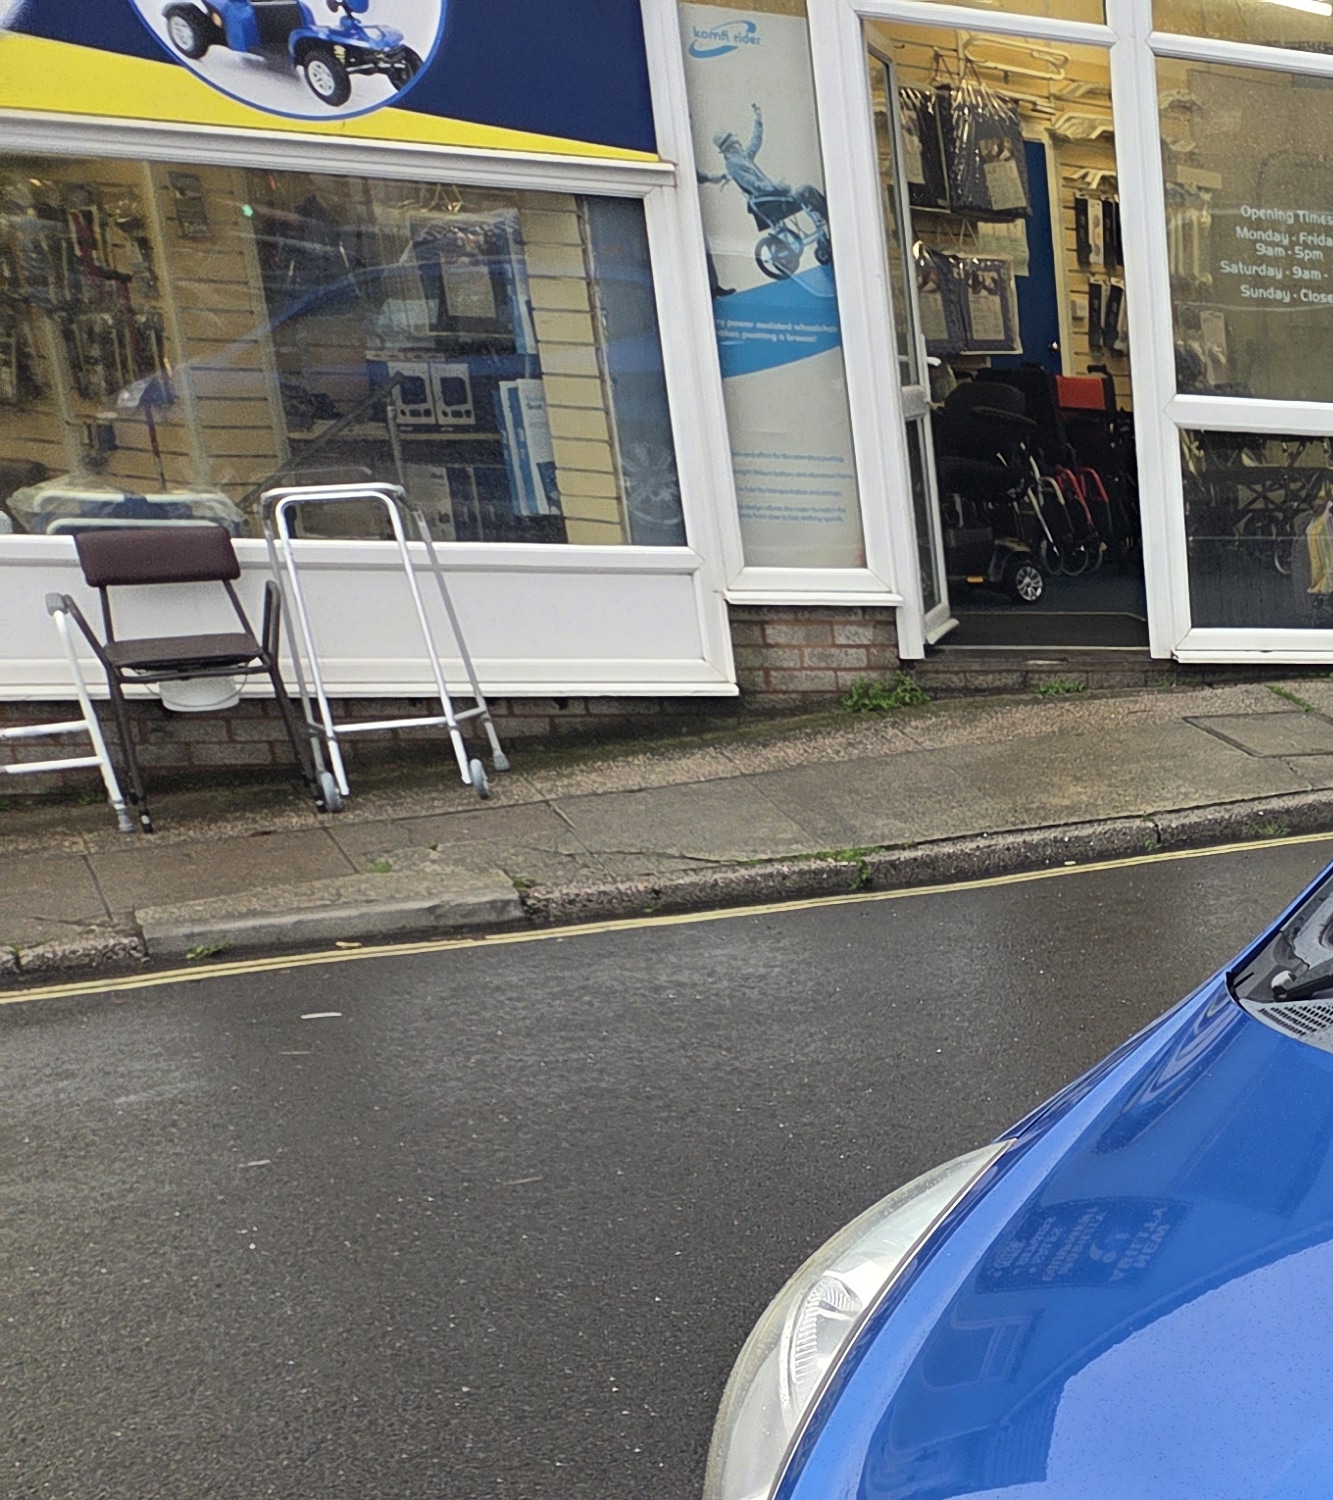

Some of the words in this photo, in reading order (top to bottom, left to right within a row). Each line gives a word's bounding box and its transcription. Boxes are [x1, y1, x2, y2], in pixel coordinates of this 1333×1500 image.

[1240, 205, 1294, 224] Opening
[1236, 226, 1289, 245] Monday
[1256, 243, 1285, 257] 9am
[1294, 246, 1324, 262] 5pm
[1220, 260, 1283, 280] Saturday
[1292, 266, 1322, 281] 9am
[1240, 284, 1290, 303] Sunday
